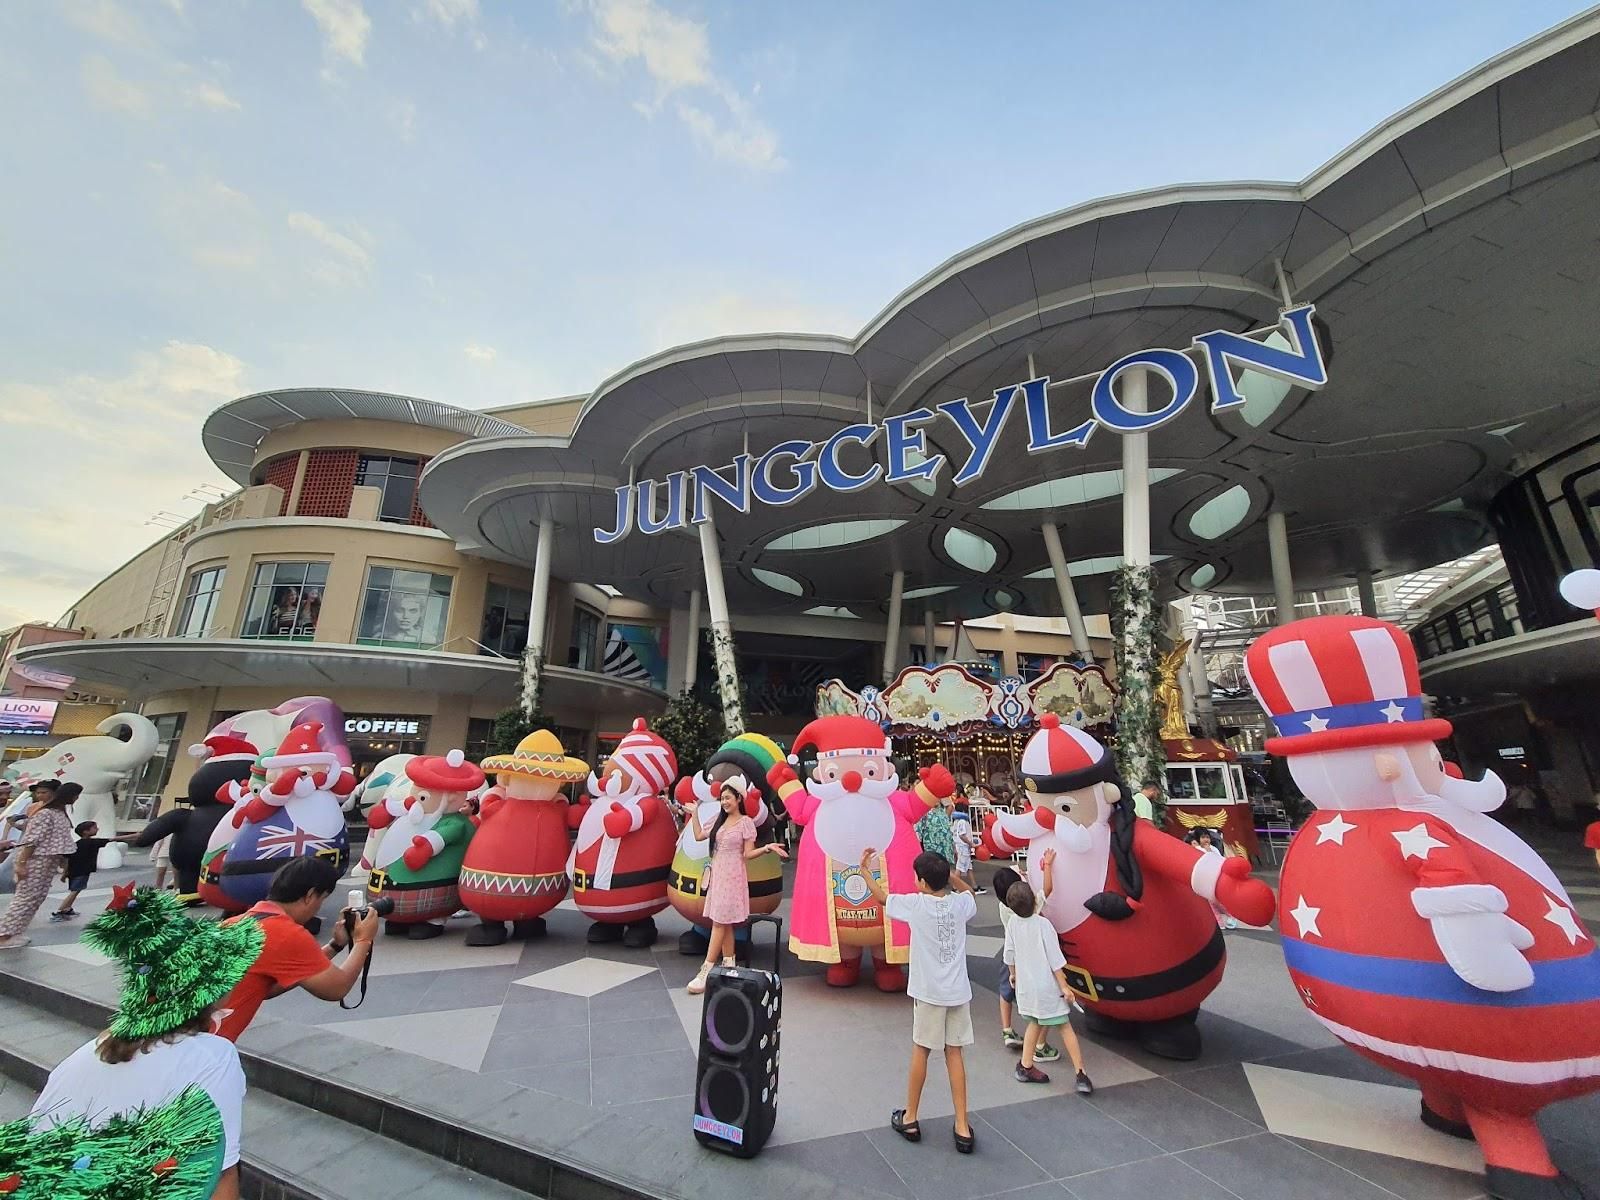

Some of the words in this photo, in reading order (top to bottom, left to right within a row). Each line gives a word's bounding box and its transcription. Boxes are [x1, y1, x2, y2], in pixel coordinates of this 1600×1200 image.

[592, 303, 1328, 545] JUNGCEYLON
[4, 703, 41, 713] LION
[344, 719, 419, 734] COFFEE
